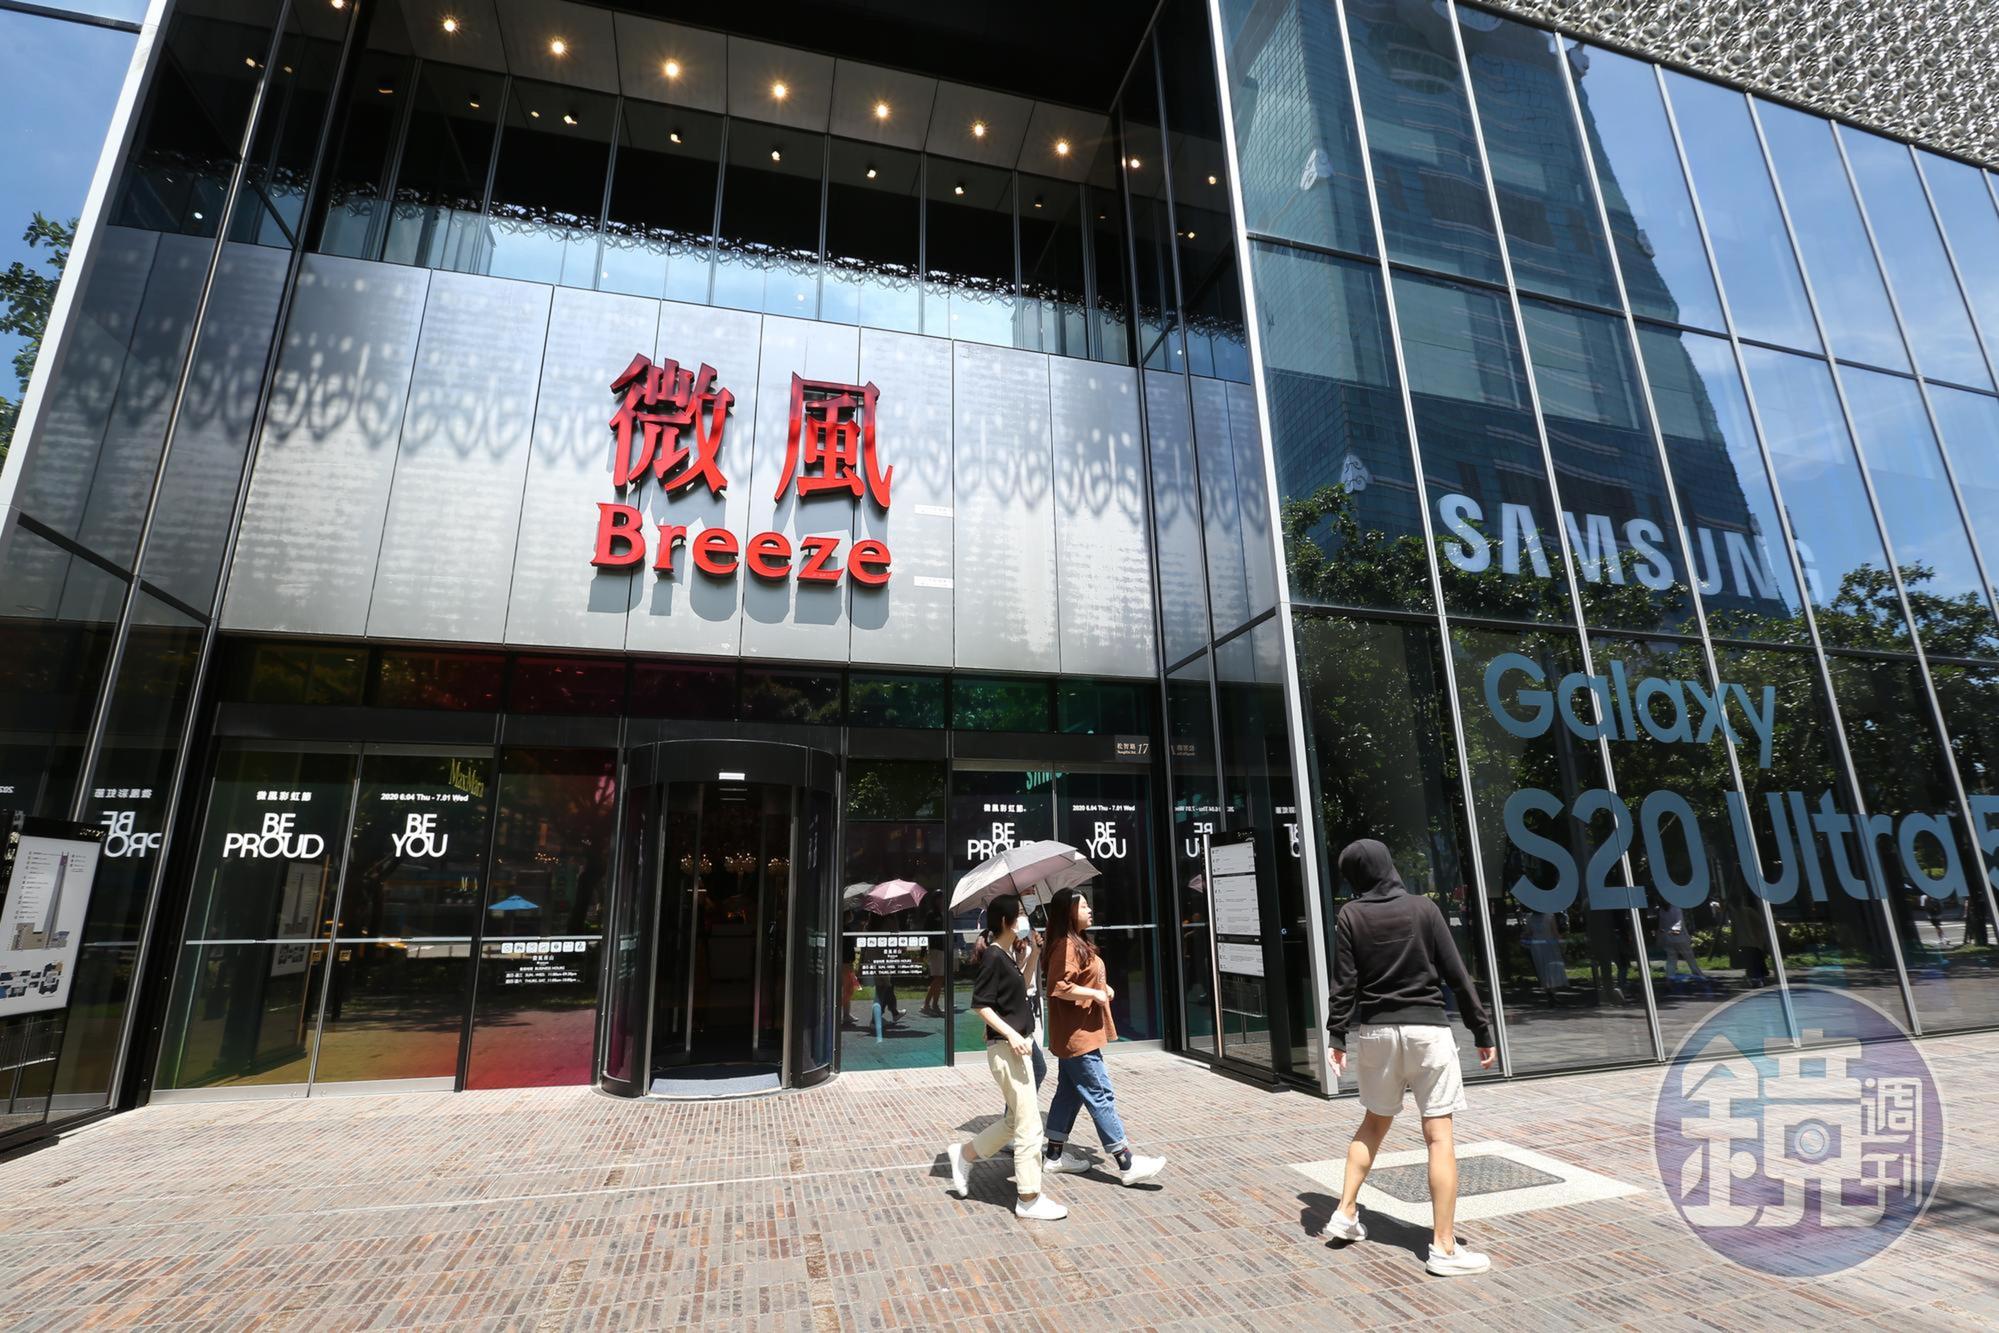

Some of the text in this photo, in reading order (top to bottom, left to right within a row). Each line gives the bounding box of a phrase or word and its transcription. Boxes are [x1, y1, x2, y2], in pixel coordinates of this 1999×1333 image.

[609, 353, 893, 511] 微風
[590, 502, 892, 586] Breeze
[1484, 652, 1776, 768] Galaxy
[1137, 743, 1149, 755] 17
[416, 793, 430, 801] Thu
[261, 813, 296, 836] BE
[405, 813, 437, 837] BE
[992, 822, 1015, 842] BE
[1094, 822, 1116, 841] BE
[222, 833, 324, 858] PROUD
[391, 833, 448, 857] YOU
[1085, 839, 1126, 859] YOU
[1502, 788, 1711, 914] S20
[1725, 790, 1970, 905] Ultra
